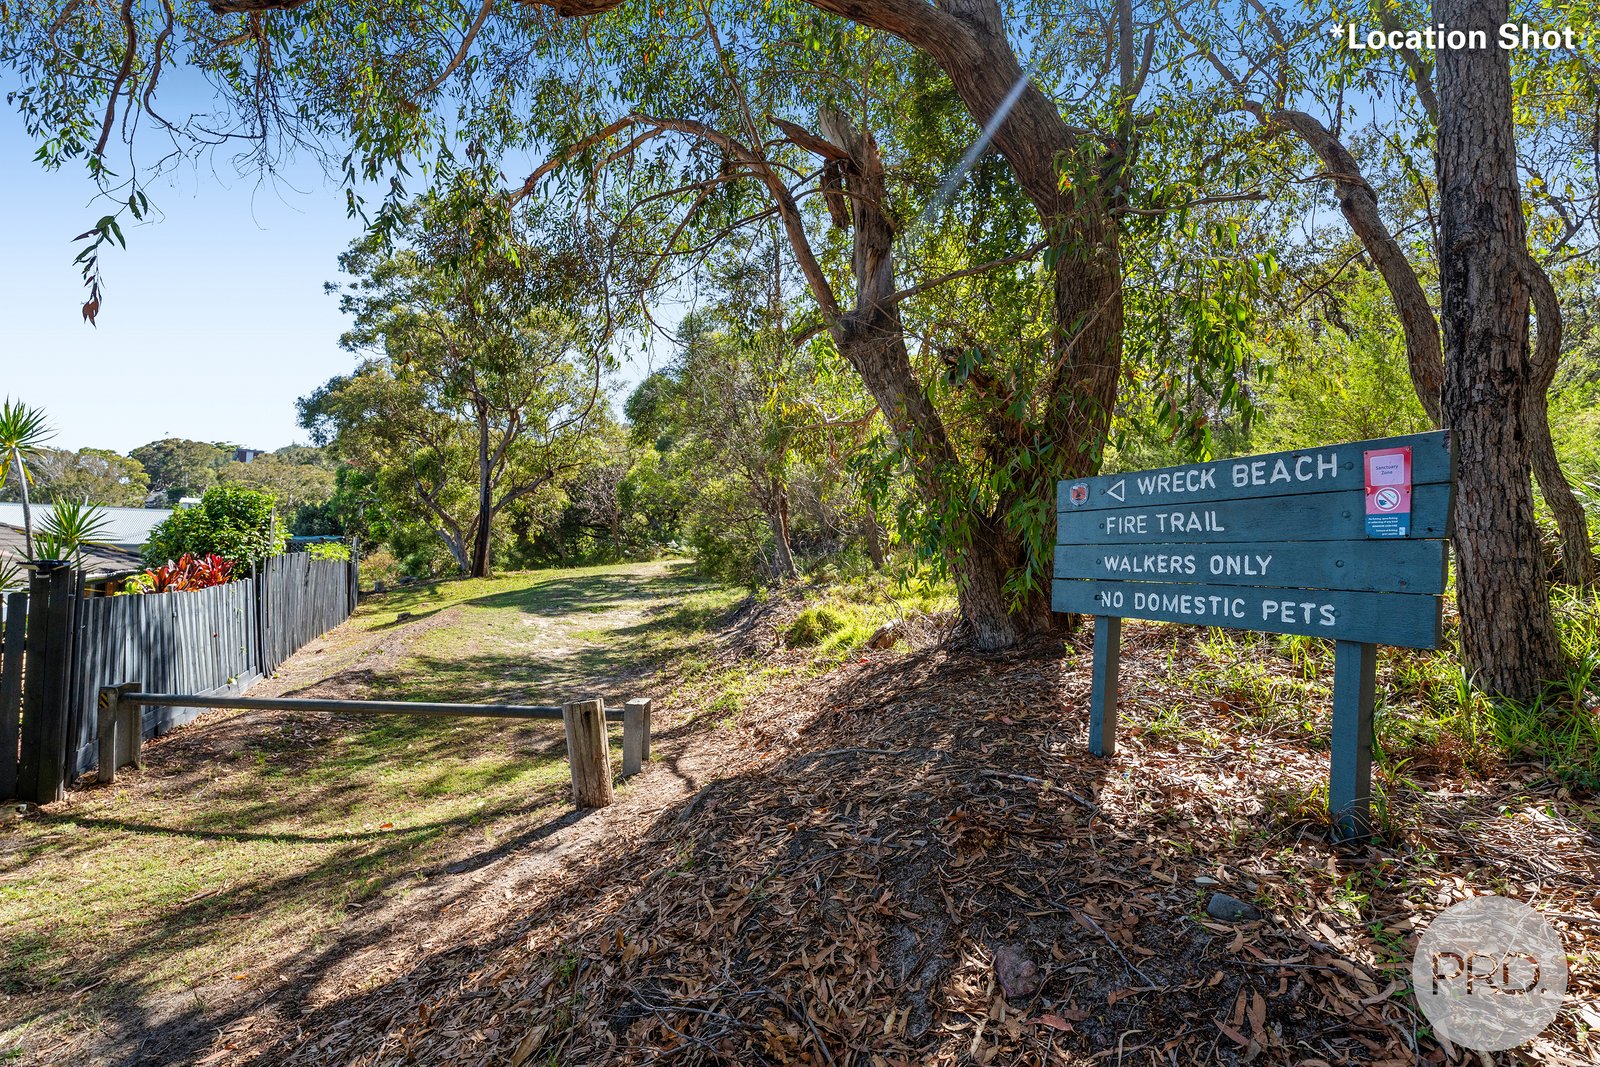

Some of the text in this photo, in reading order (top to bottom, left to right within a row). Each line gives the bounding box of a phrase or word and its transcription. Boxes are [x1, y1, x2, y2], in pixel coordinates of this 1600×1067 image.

[1137, 453, 1338, 496] WRECK BEACH
[1106, 510, 1225, 535] FIRE TRAIL
[1103, 553, 1273, 576] WALKERS ONLY
[1101, 590, 1336, 626] NO DOMESTIC PETS
